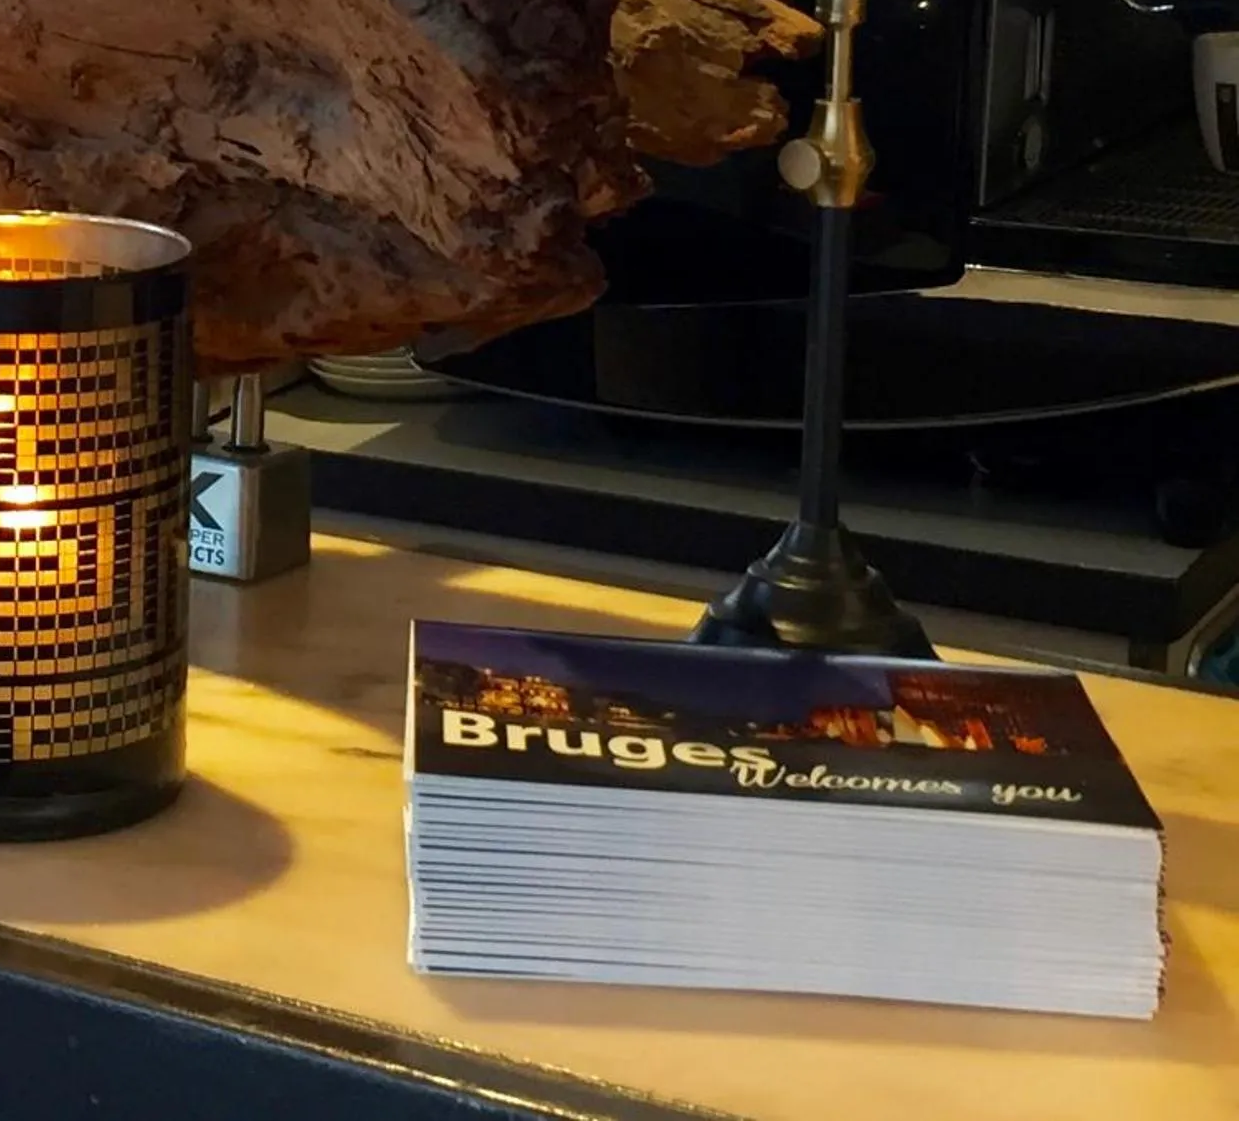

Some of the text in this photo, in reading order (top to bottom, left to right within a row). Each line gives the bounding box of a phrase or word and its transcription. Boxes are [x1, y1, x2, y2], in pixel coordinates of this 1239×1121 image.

[441, 708, 778, 770] Bruges
[729, 762, 1083, 806] Welcomes you
